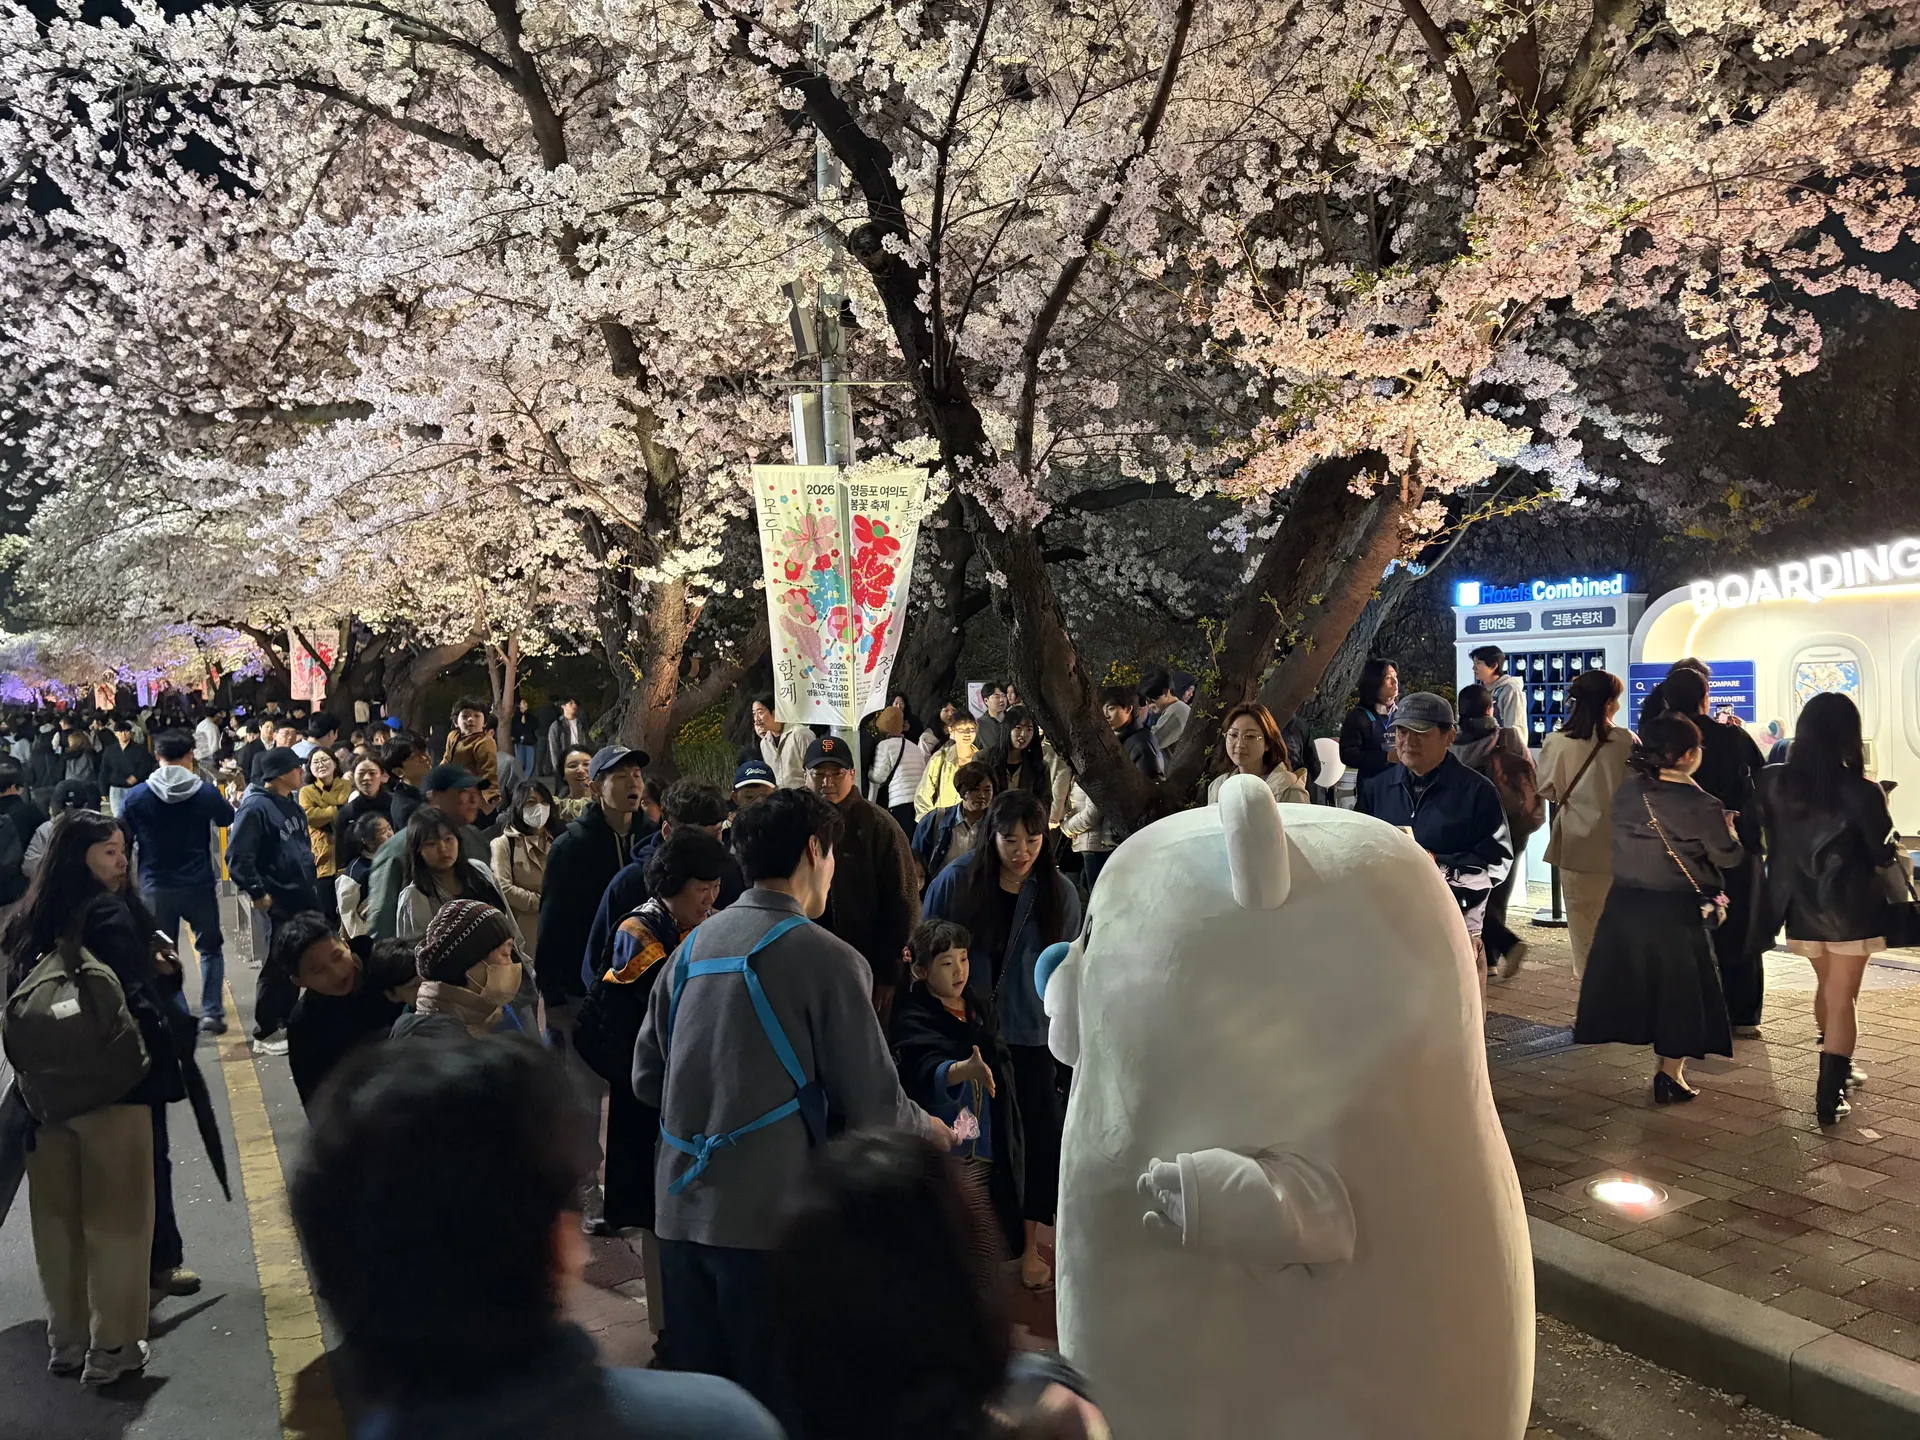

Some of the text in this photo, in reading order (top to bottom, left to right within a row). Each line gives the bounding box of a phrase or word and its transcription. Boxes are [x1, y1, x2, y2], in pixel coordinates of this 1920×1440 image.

[806, 484, 836, 496] 2026
[850, 484, 908, 498] 영등포 여의도
[850, 499, 890, 512] 봄꽃 축제
[1689, 538, 1920, 616] BOARDING
[1482, 573, 1623, 604] HotelsCombined
[1478, 611, 1603, 631] 참여인증 경품수령처
[1708, 680, 1740, 688] COMPARE
[806, 689, 826, 697] 영등구
[1709, 695, 1746, 703] ERYWHERE
